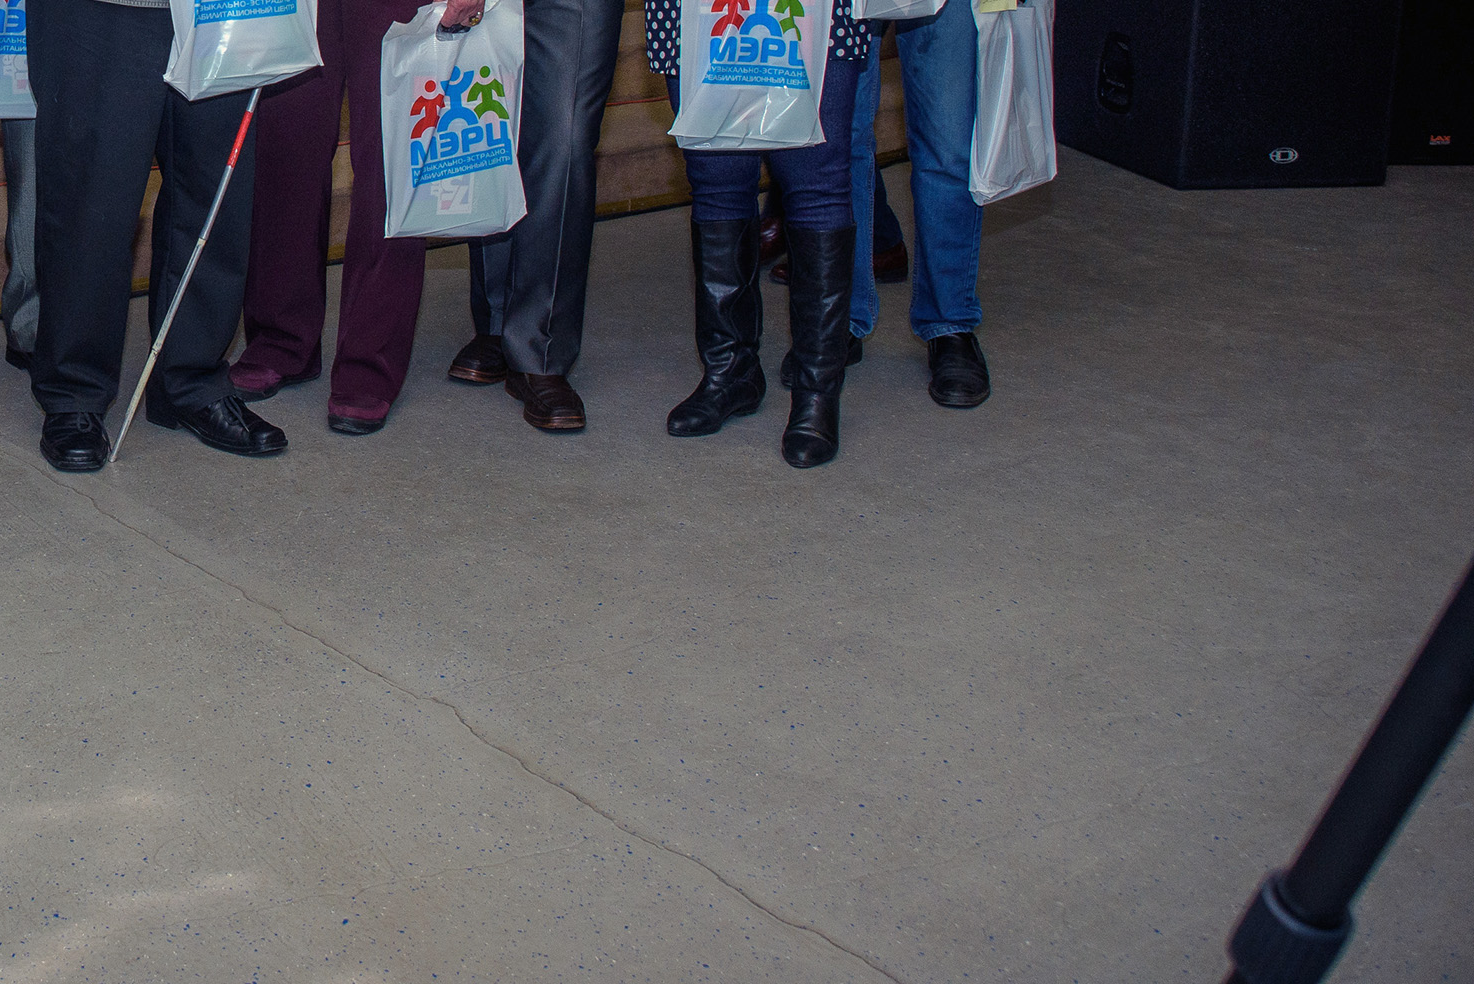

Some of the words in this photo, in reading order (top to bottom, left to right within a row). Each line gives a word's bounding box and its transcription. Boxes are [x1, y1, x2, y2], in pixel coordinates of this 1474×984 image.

[197, 6, 273, 21] АБИЛИТАЦИОННЫЙ
[273, 3, 295, 14] ЦЕНТР
[410, 120, 512, 166] МЭРЦ
[413, 148, 509, 177] МЫКАЛЬНО-ЭСТРАДНО-
[414, 161, 487, 185] РАБИЛИТАЦИОННЫЙ
